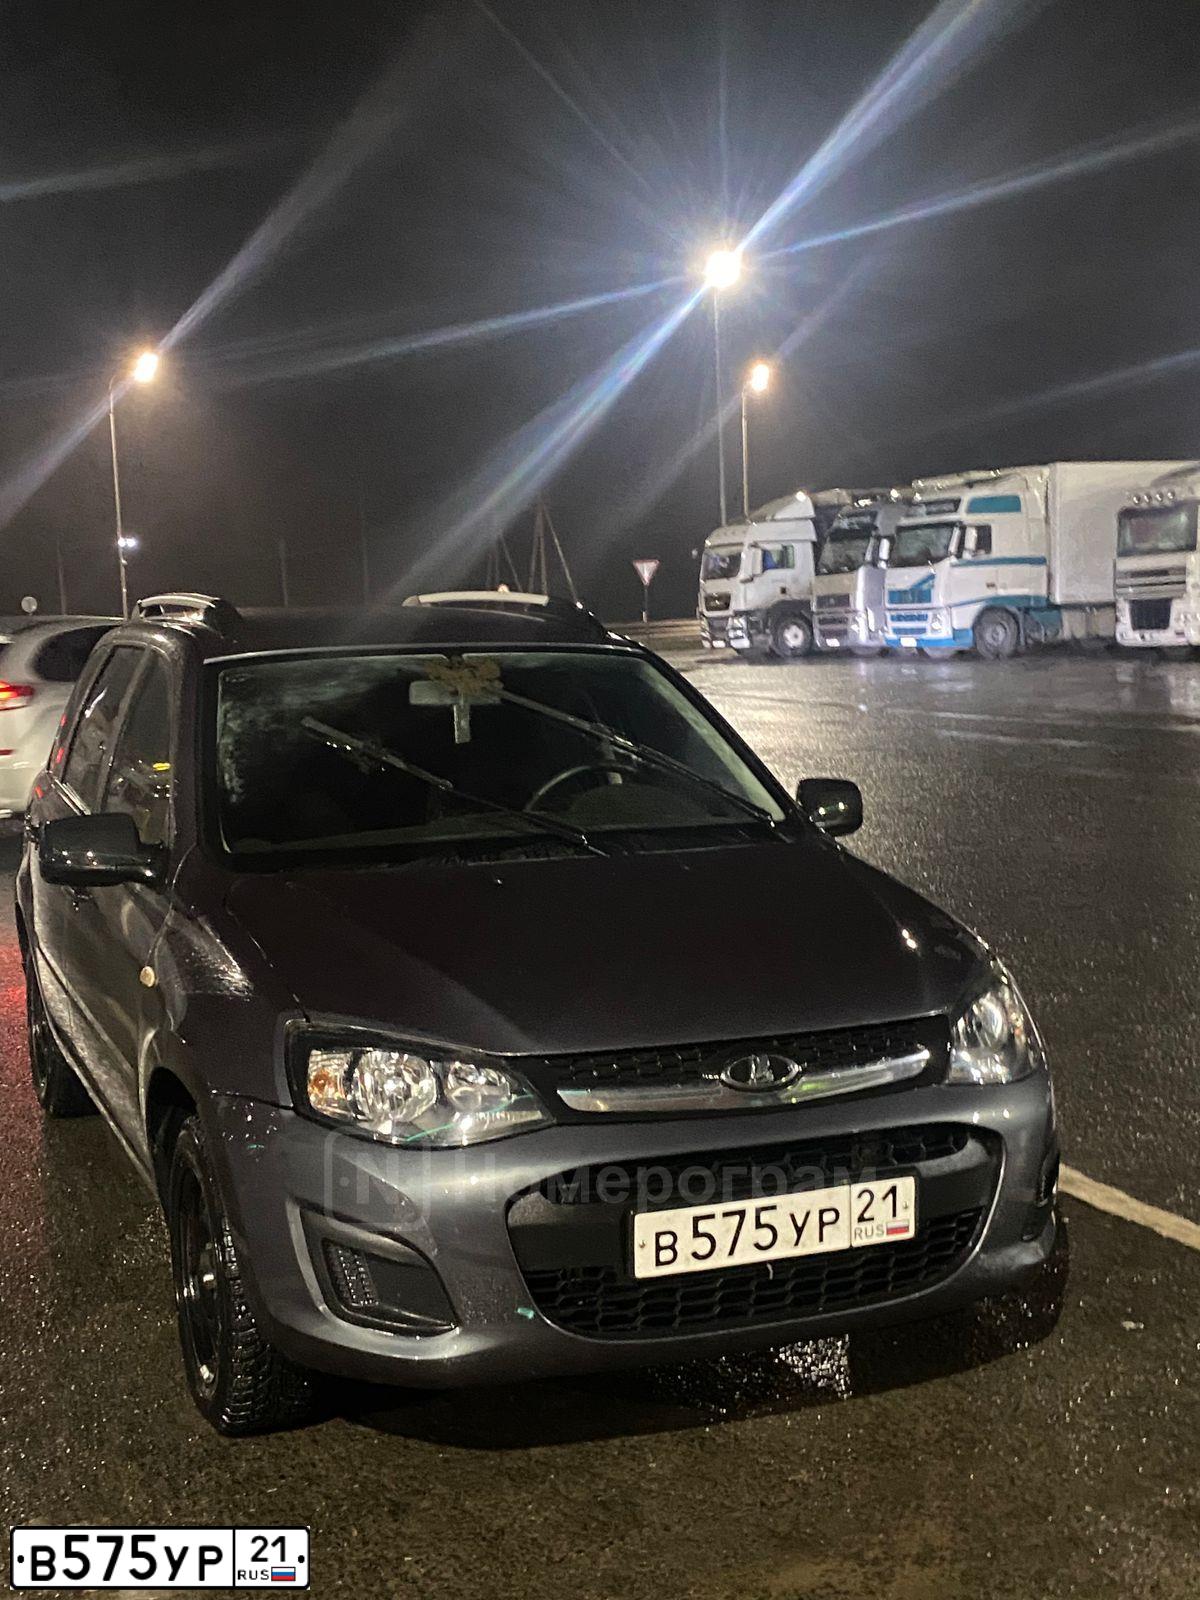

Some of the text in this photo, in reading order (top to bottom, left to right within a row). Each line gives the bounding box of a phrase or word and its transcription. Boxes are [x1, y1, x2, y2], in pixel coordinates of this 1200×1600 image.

[655, 1185, 897, 1267] В575УР 21
[854, 1223, 885, 1241] RUS
